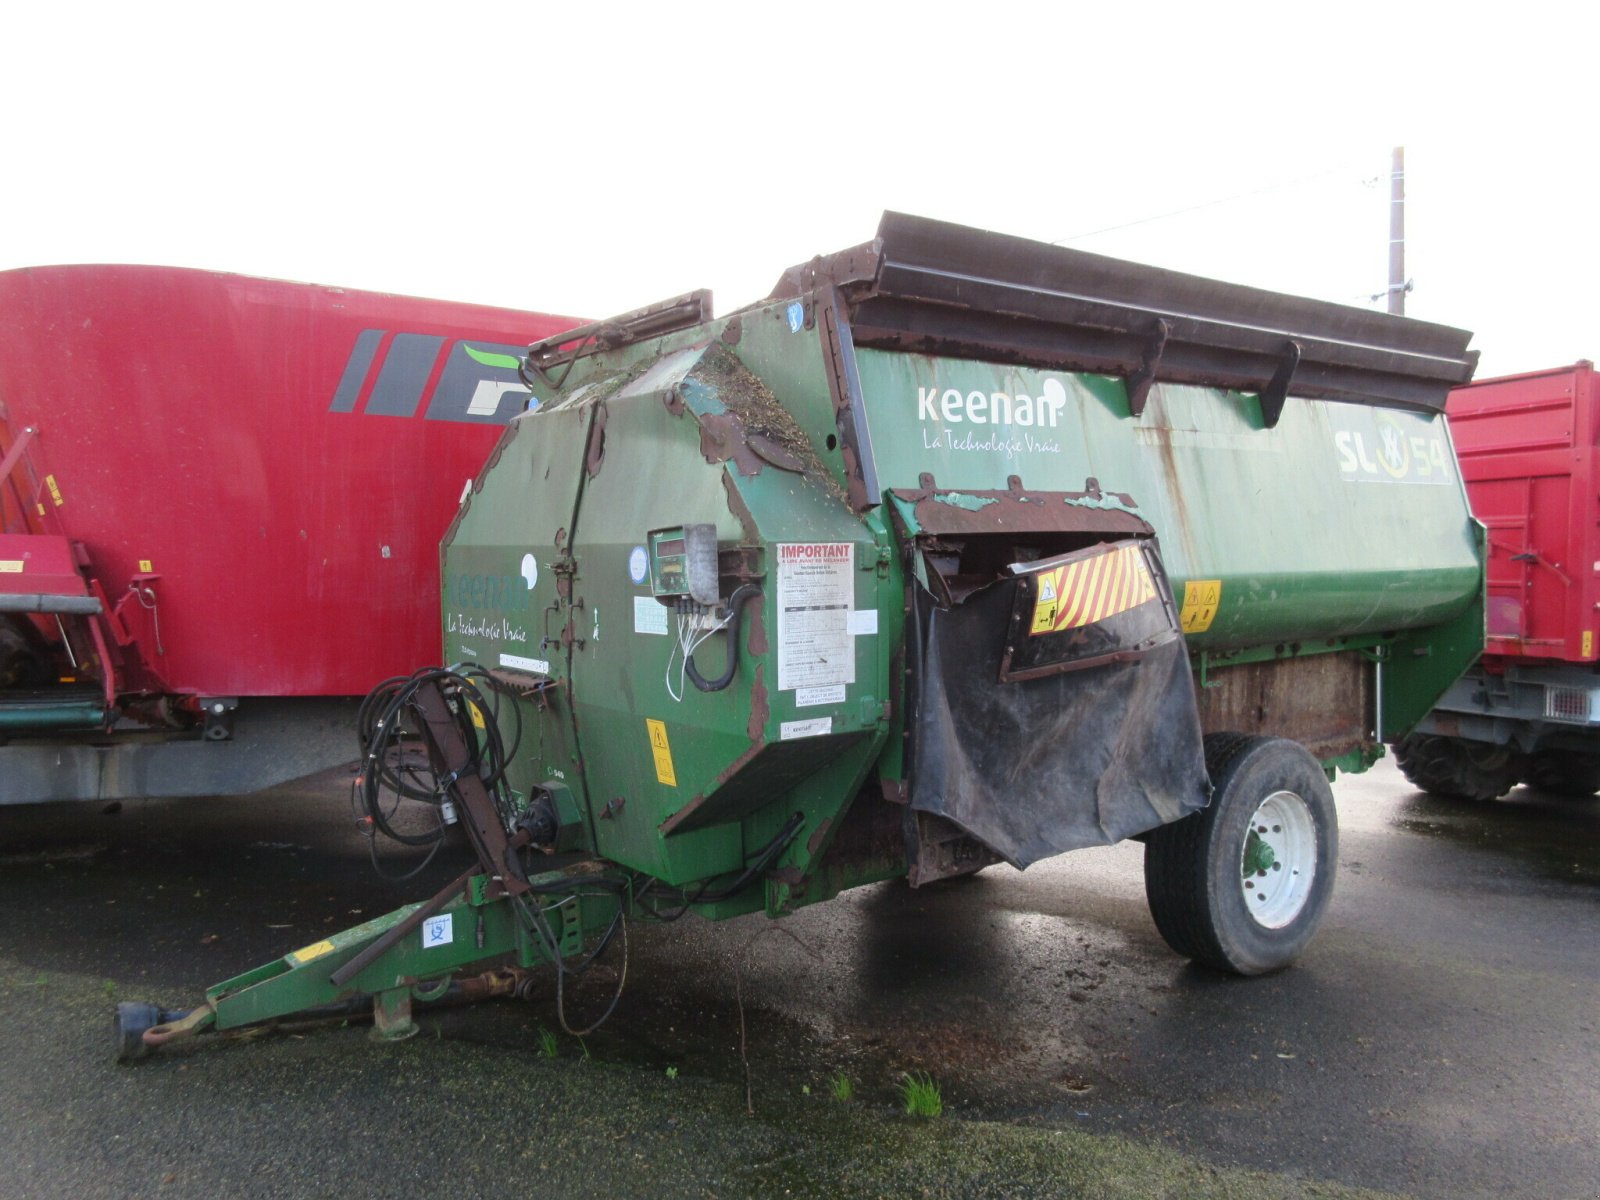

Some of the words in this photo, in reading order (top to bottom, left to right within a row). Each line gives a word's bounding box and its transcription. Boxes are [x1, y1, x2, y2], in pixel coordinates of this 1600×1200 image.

[923, 427, 942, 450] La
[944, 429, 1023, 459] Technologie
[1024, 433, 1062, 454] Vraie
[1335, 431, 1377, 474] SL
[781, 545, 850, 558] IMPORTANT
[448, 612, 457, 633] La
